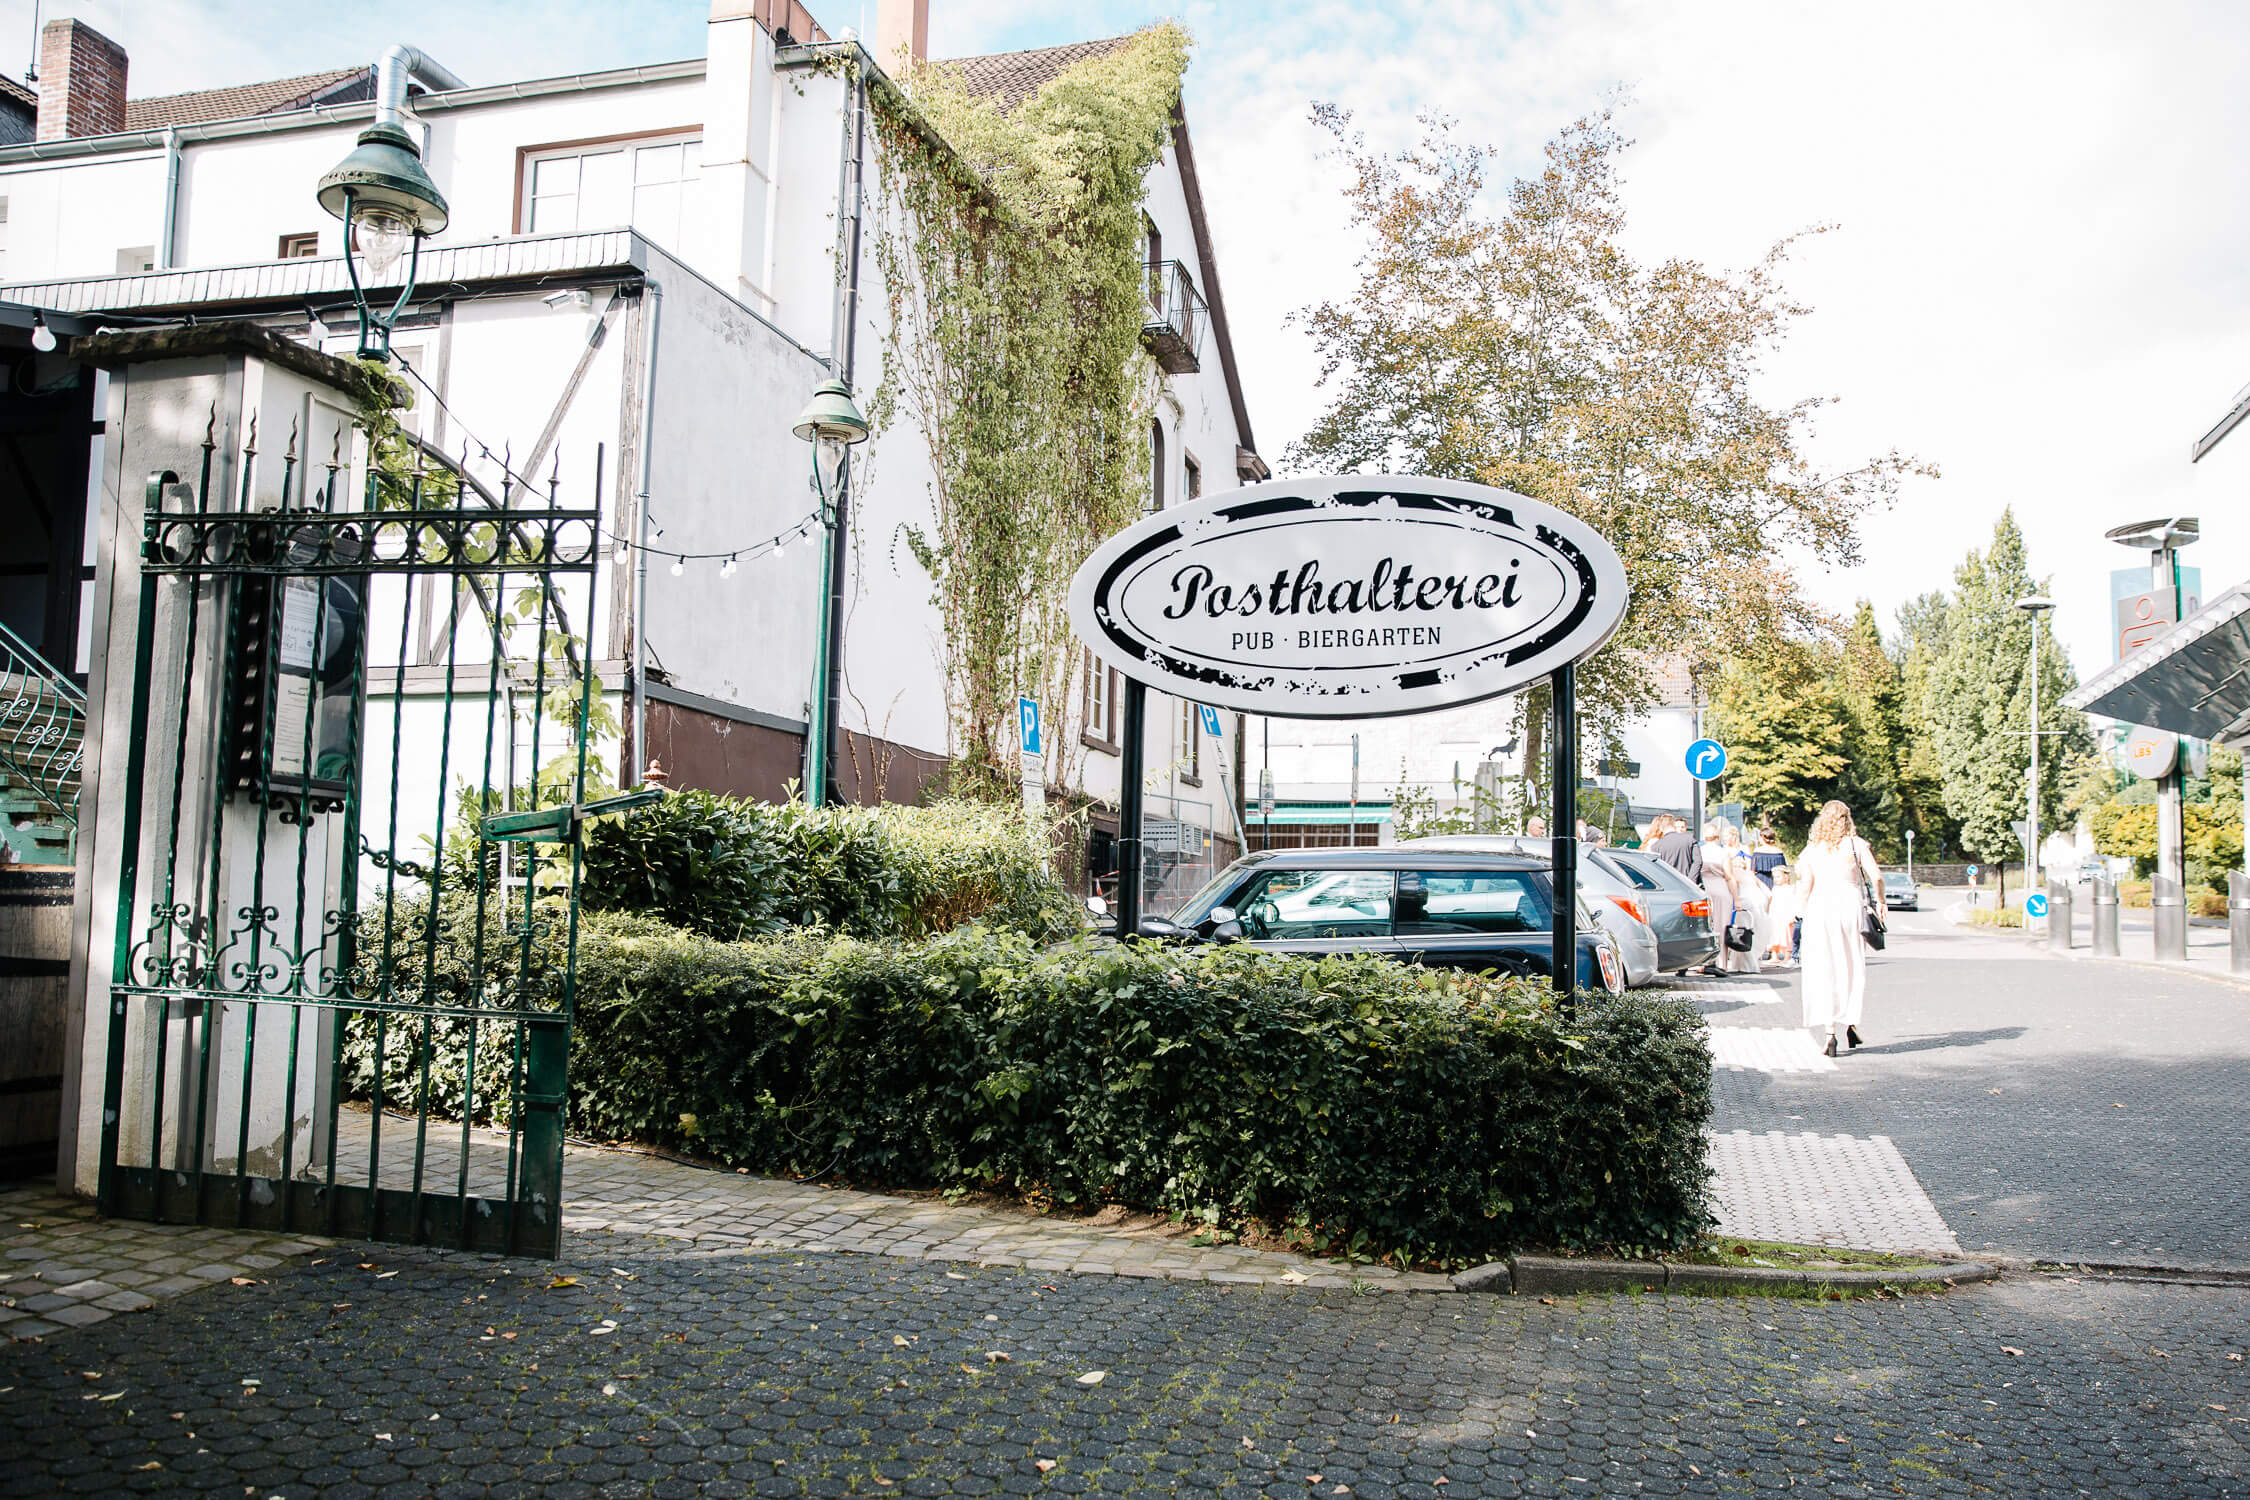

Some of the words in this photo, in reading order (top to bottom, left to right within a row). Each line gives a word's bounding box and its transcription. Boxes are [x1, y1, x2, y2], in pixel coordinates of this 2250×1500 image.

[1164, 557, 1522, 620] Posthalterei
[1231, 631, 1275, 651] PUB
[1298, 626, 1441, 649] BIERGARTEN
[1023, 706, 1036, 745] P
[1203, 706, 1215, 733] P
